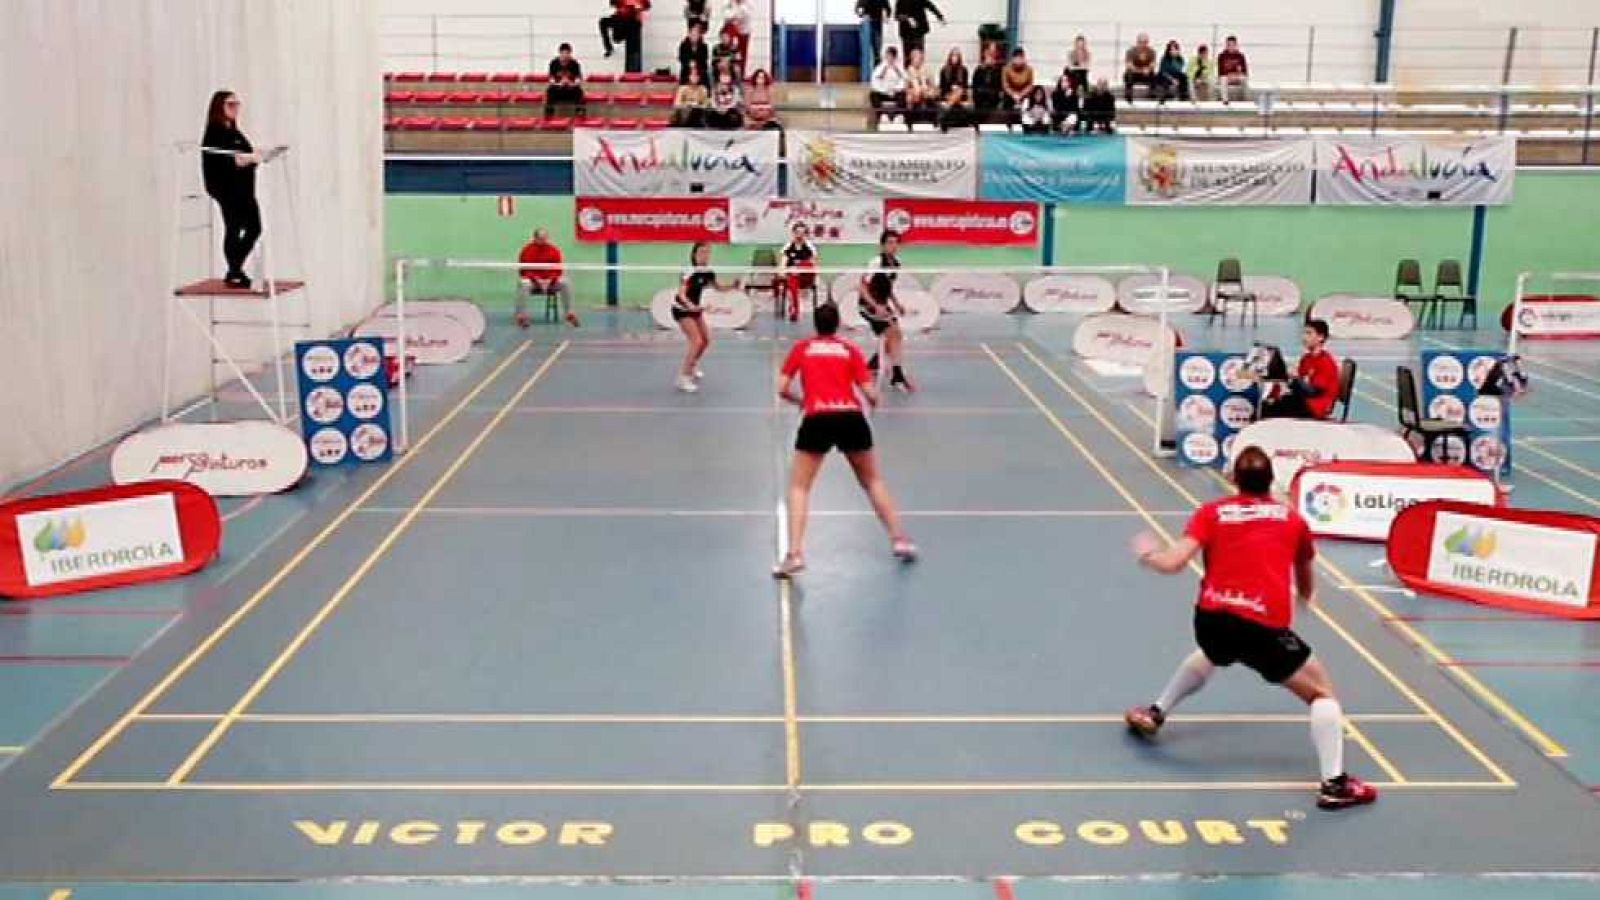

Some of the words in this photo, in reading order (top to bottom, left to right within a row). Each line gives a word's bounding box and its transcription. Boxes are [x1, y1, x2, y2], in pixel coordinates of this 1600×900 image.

[51, 541, 173, 575] IBERDROLA
[1452, 561, 1579, 597] IBERDROLA
[294, 820, 614, 846] VICTOR
[753, 820, 914, 846] PRO
